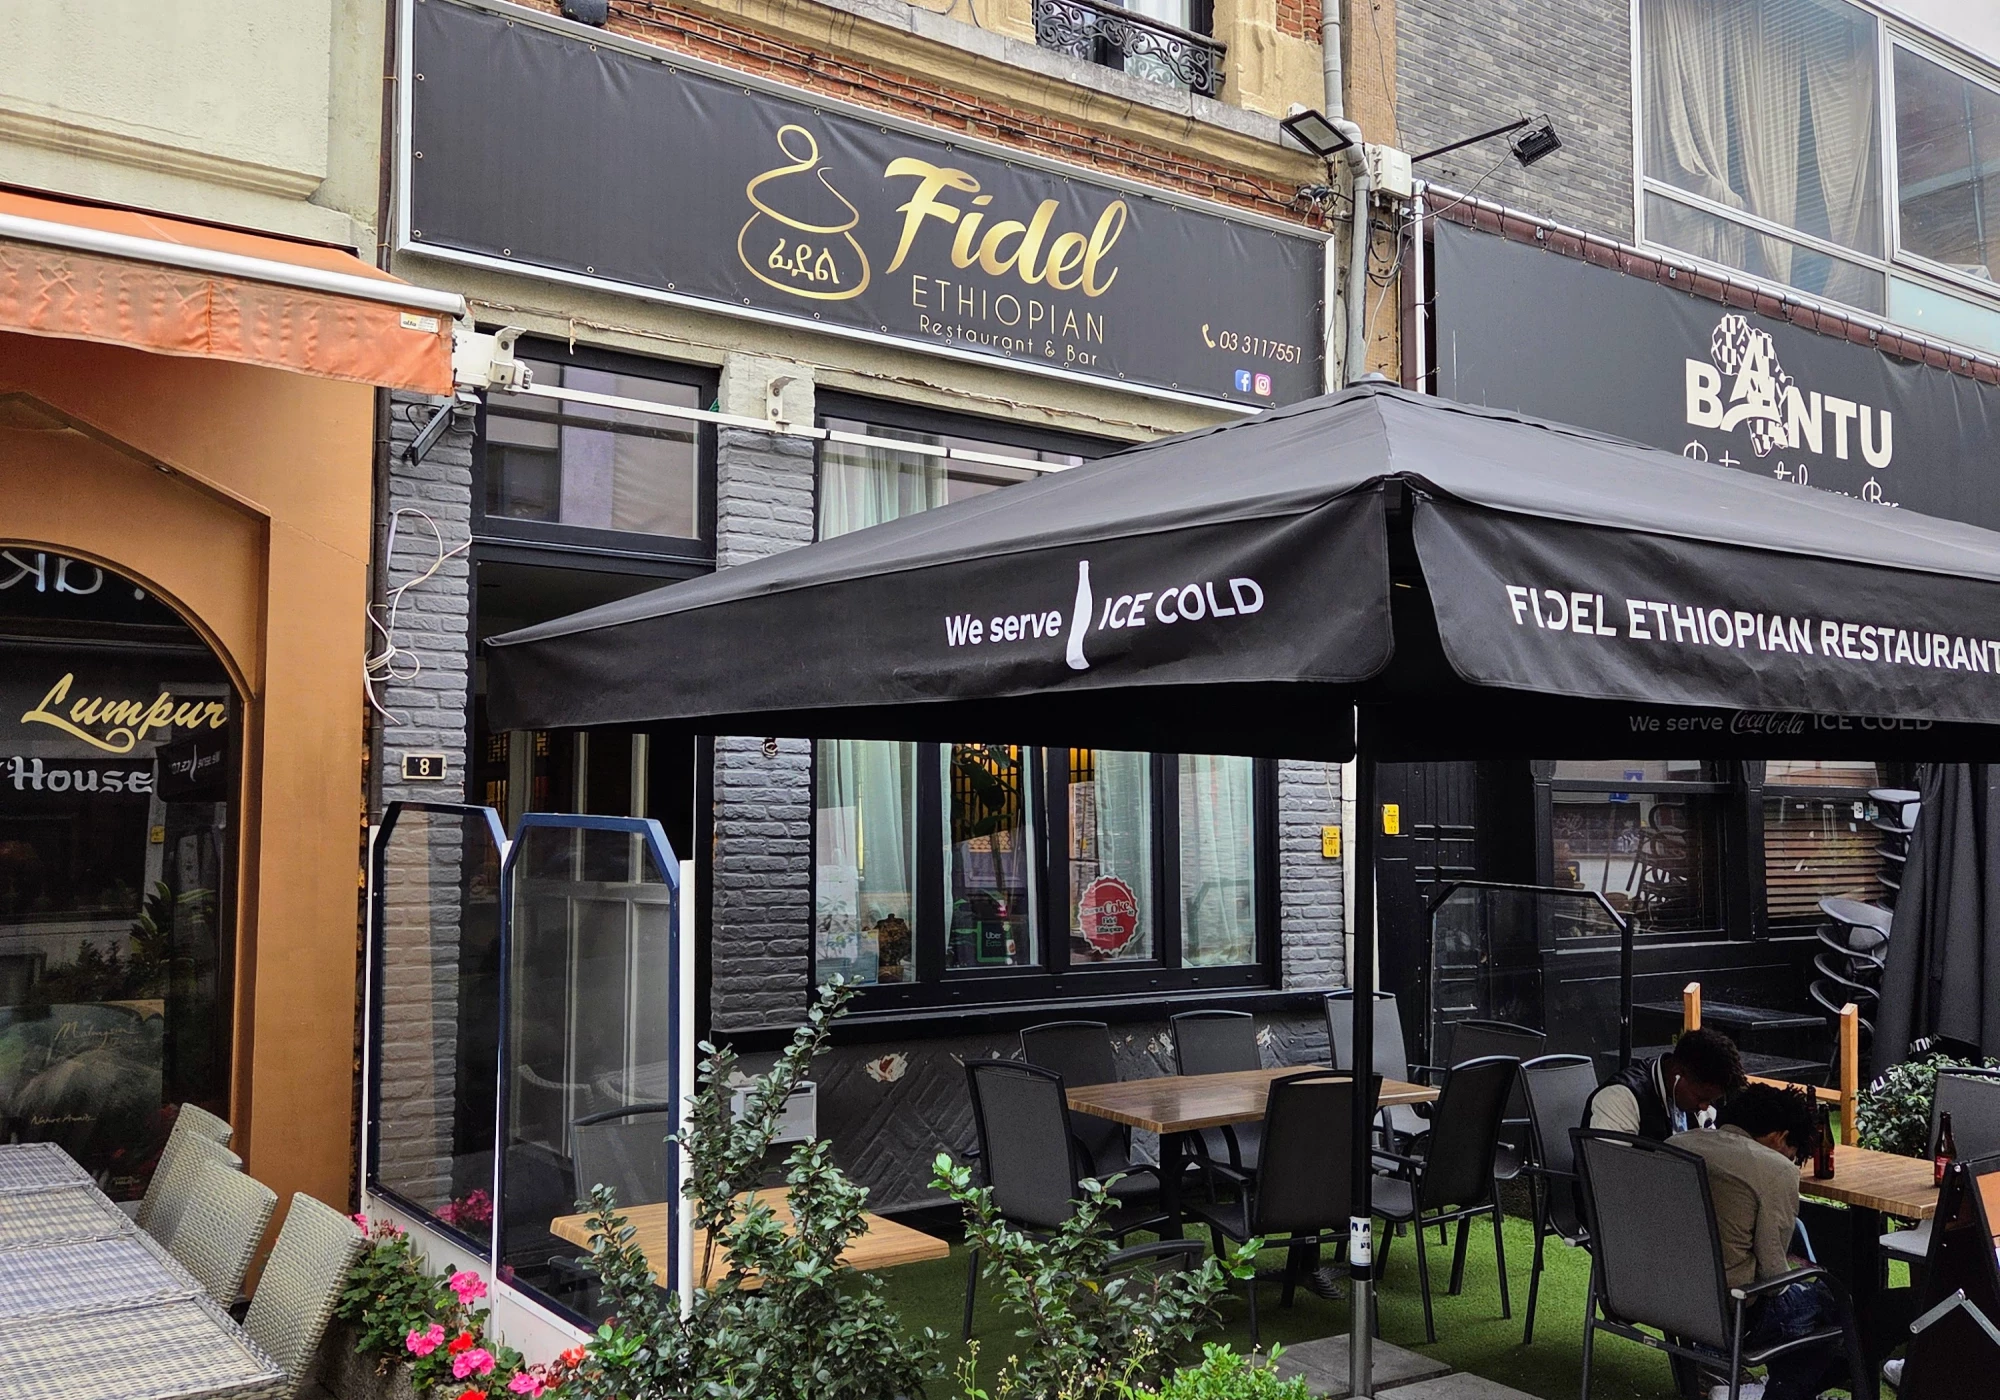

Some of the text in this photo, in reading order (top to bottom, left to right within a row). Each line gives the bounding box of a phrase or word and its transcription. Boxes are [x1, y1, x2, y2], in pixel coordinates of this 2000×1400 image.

[884, 157, 1128, 298] Fidel
[768, 238, 840, 284] ፊደል
[912, 274, 1104, 344] ETHIOPIAN
[919, 314, 1098, 366] Restaurant & Bar
[1219, 330, 1301, 365] 03 3117551
[1685, 329, 1893, 469] BANTU
[945, 577, 1265, 647] We serve ICE COLD
[1506, 584, 1617, 638] FIDEL
[1626, 598, 1814, 655] ETHIOPIAN
[20, 673, 228, 754] Lumpur
[1629, 715, 1660, 732] We
[1666, 717, 1724, 732] serve
[1813, 713, 1853, 730] ICE
[420, 758, 430, 776] 8
[985, 931, 1002, 939] Uber
